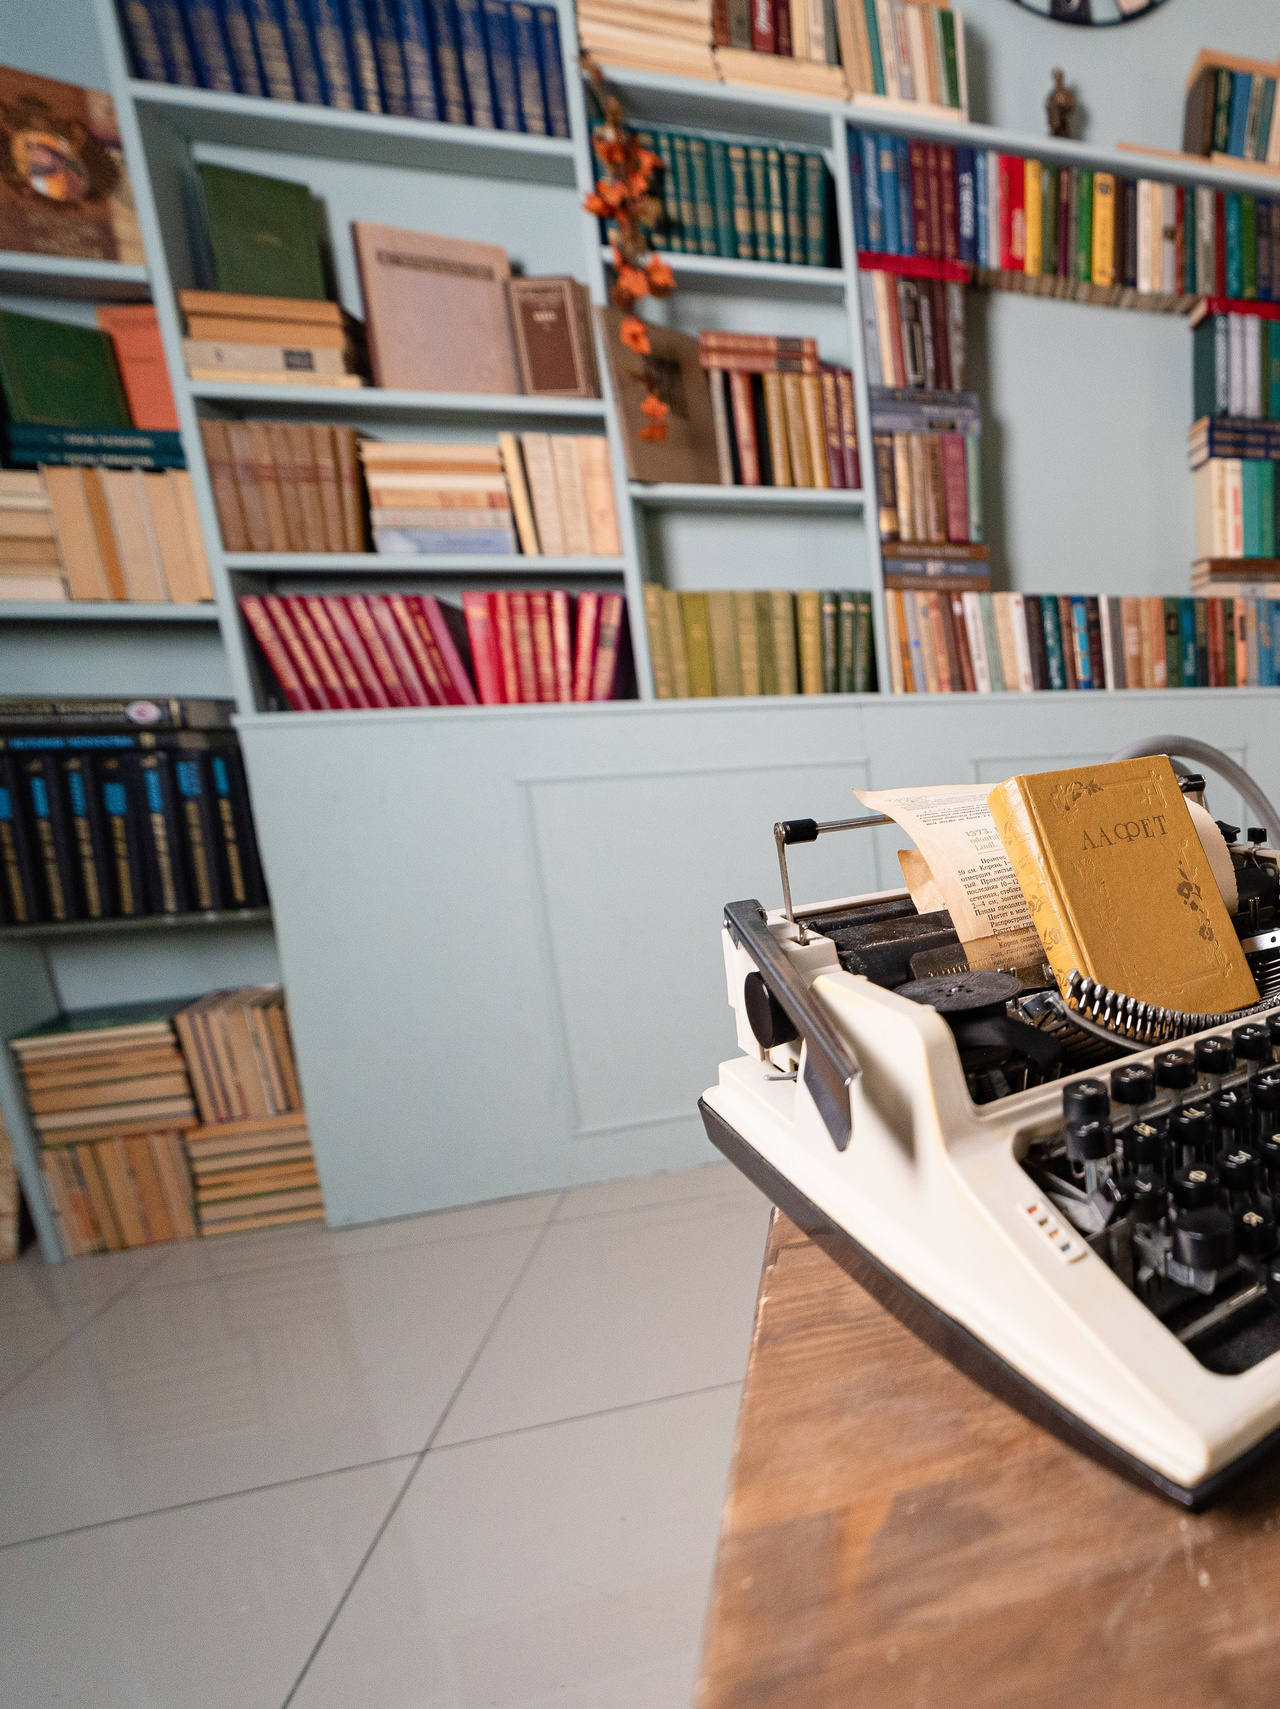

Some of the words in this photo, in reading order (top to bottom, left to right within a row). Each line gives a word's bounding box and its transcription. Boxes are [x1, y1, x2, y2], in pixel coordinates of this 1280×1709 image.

[974, 841, 998, 851] Lindl.
[979, 862, 1003, 871] Корень
[961, 872, 991, 882] отмерших
[975, 906, 996, 917] Плоды
[987, 911, 1009, 921] Цветет
[1261, 1075, 1280, 1086] К
[1222, 1091, 1238, 1103] У
[1182, 1107, 1206, 1120] Ц
[1228, 1150, 1252, 1164] Ы
[1242, 1211, 1264, 1227] Я
